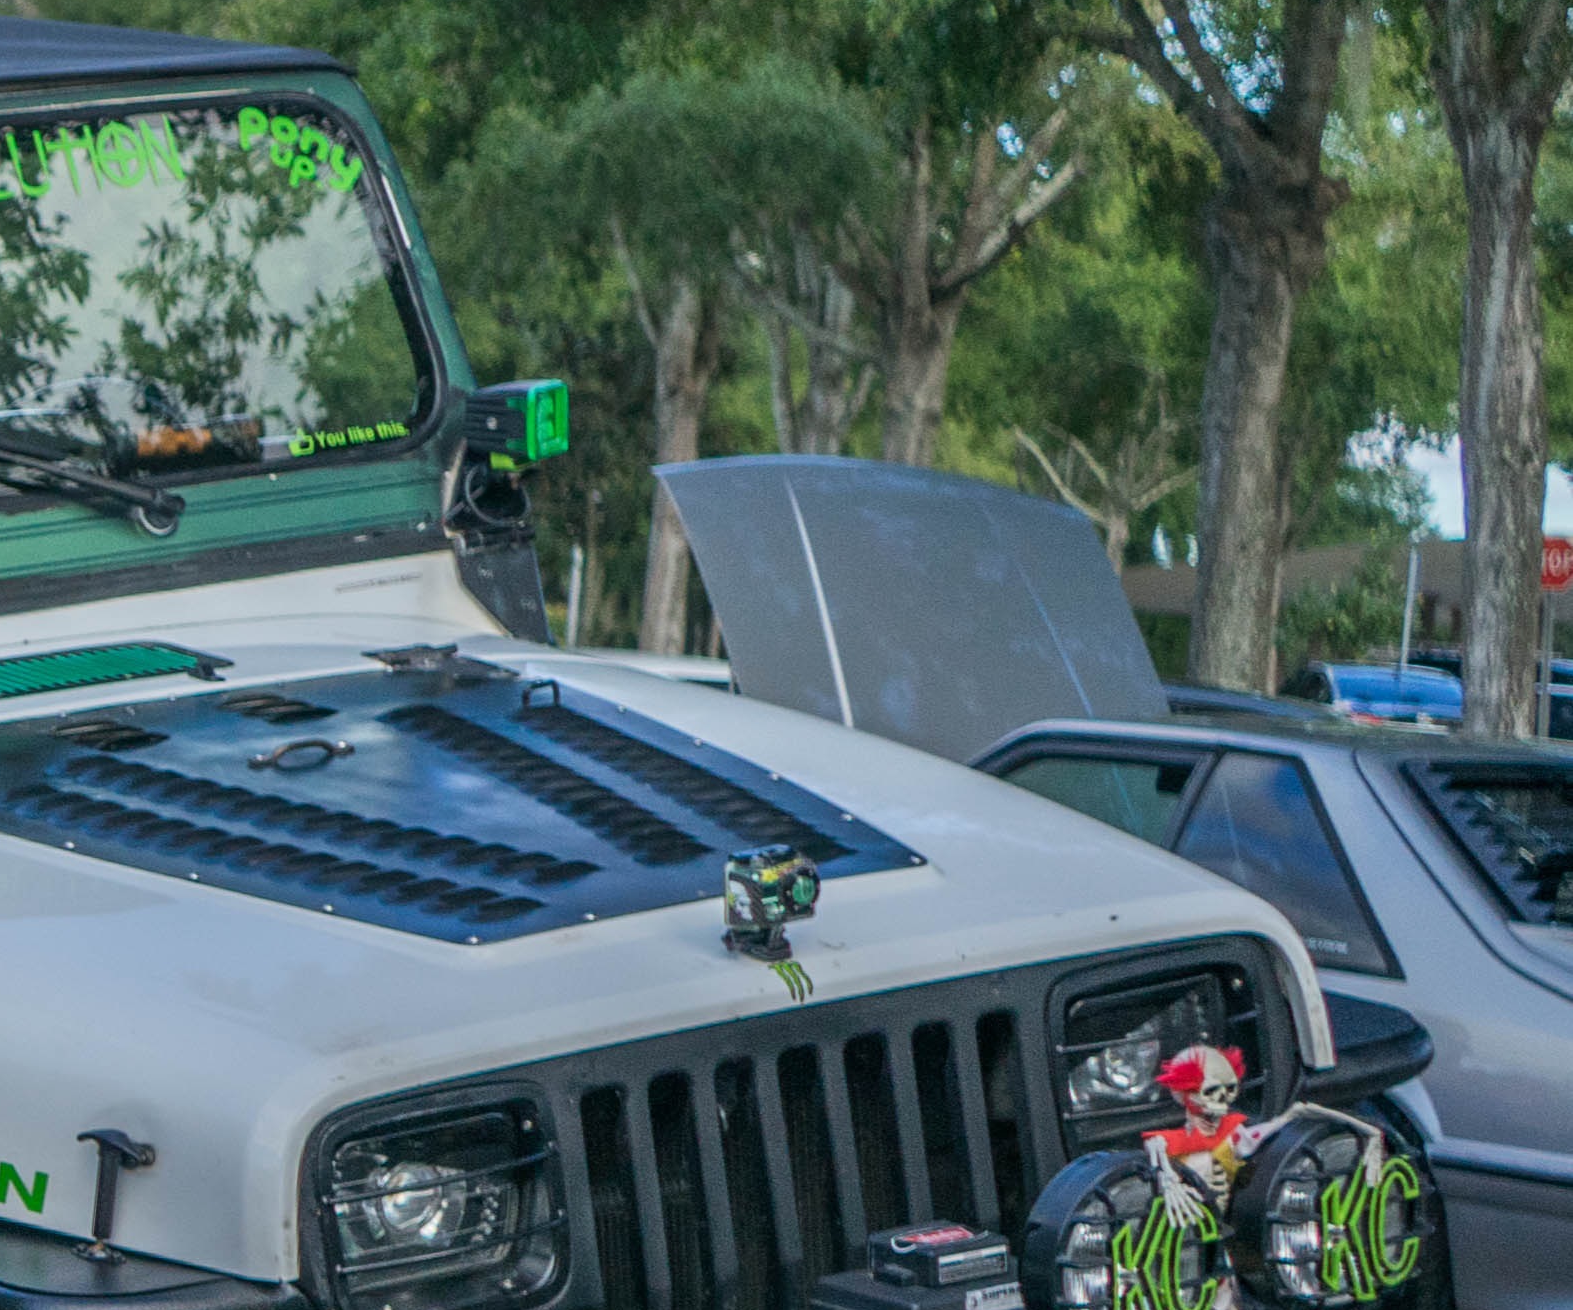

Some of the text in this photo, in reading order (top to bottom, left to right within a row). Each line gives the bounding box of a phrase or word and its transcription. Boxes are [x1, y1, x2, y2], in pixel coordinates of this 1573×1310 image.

[315, 431, 347, 449] You
[347, 426, 376, 445] like
[1322, 1156, 1421, 1302] KC
